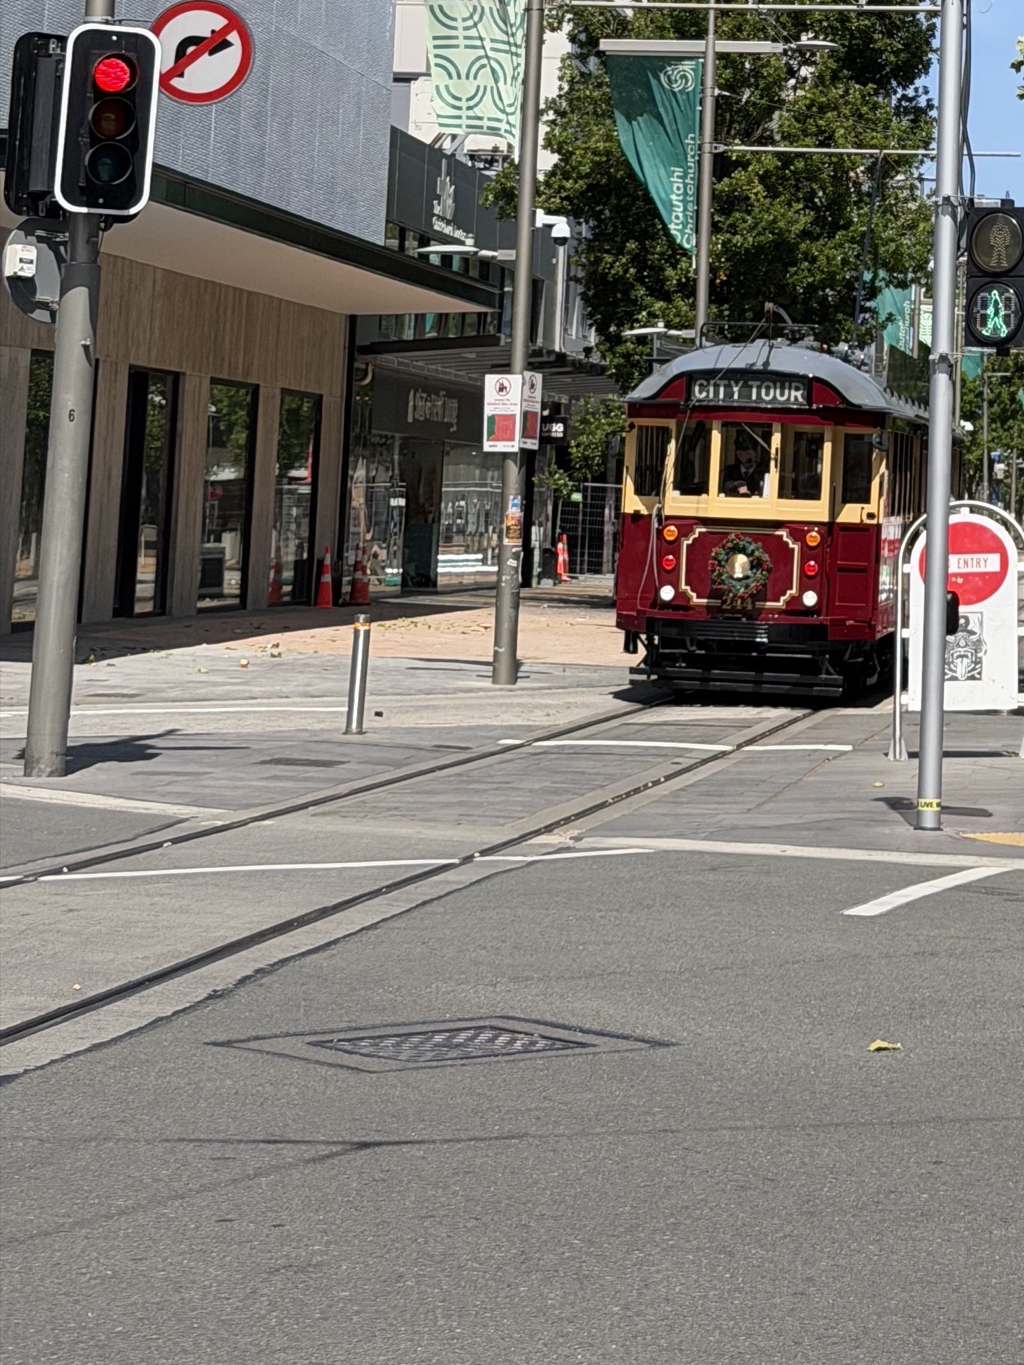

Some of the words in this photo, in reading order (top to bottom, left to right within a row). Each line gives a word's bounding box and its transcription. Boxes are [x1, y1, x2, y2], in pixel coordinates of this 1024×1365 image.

[694, 379, 743, 400] CITY
[748, 380, 804, 402] TOUR
[68, 408, 76, 423] 6
[957, 557, 989, 570] ENTRY
